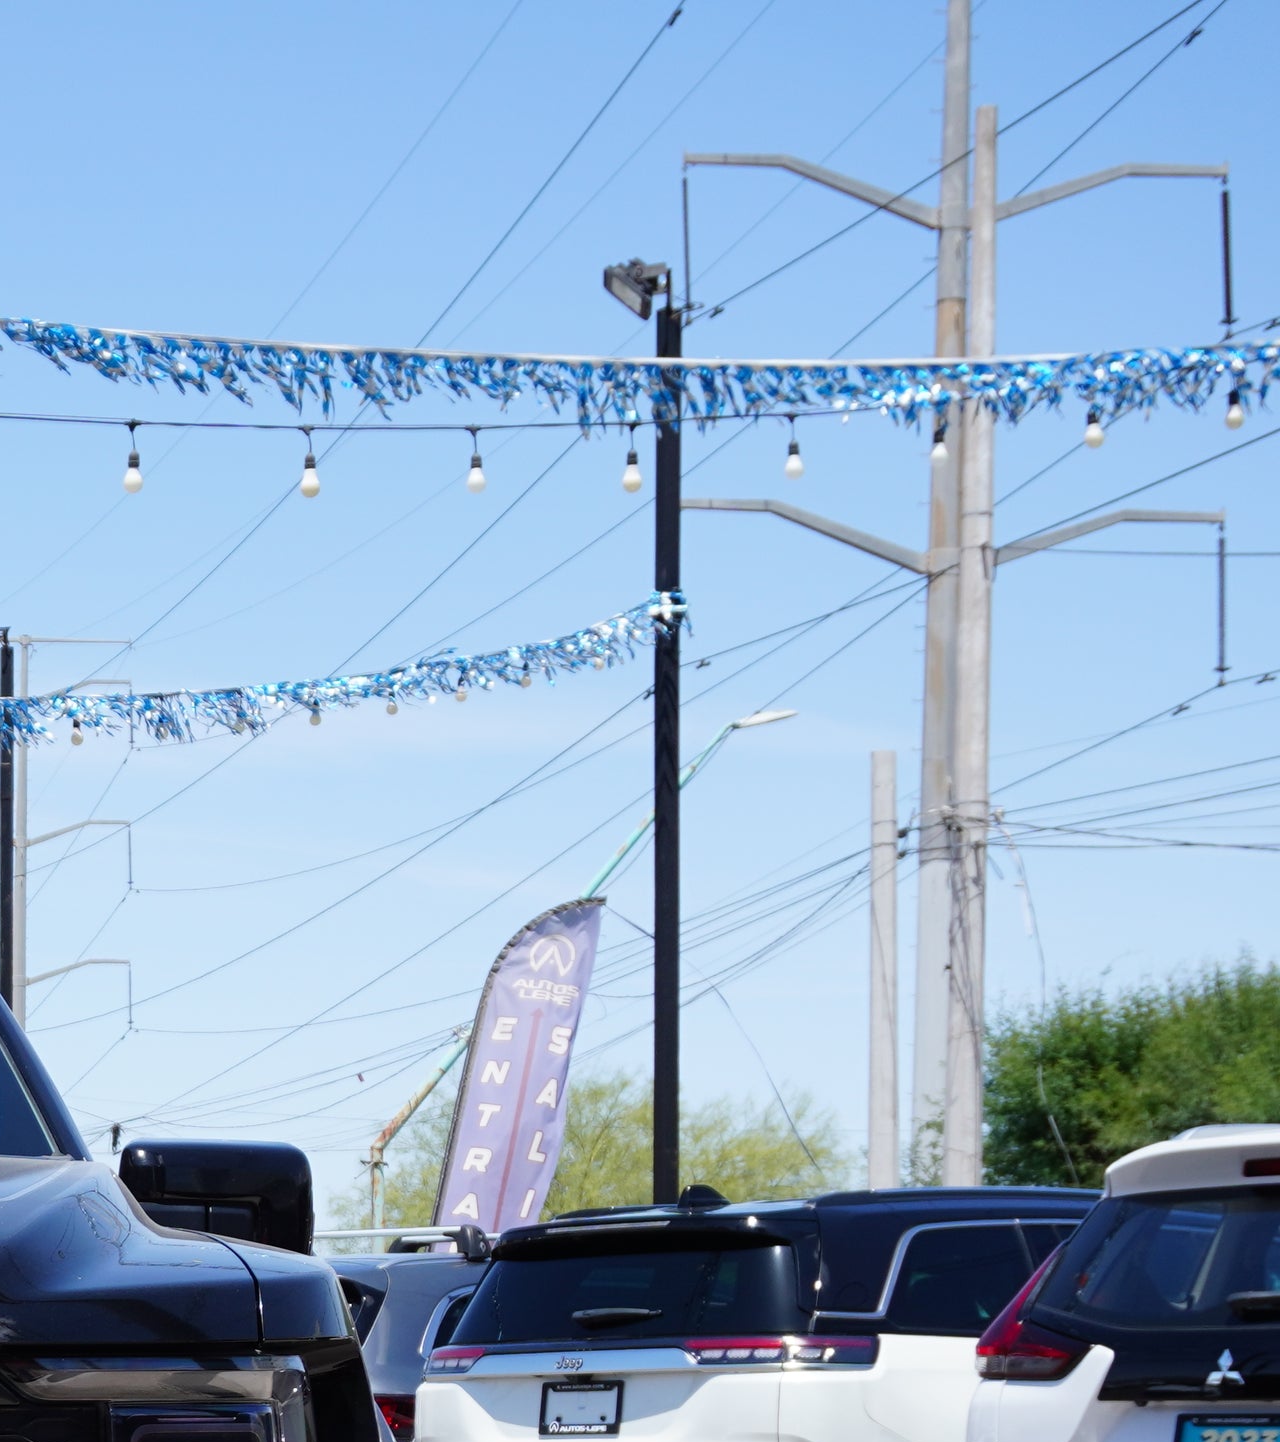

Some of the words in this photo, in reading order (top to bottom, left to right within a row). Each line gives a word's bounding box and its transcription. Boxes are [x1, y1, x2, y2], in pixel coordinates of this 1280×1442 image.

[512, 978, 580, 998] AUTOS
[519, 988, 571, 1007] LEPE
[449, 1016, 518, 1253] ENTRA
[554, 1356, 584, 1371] Jeep
